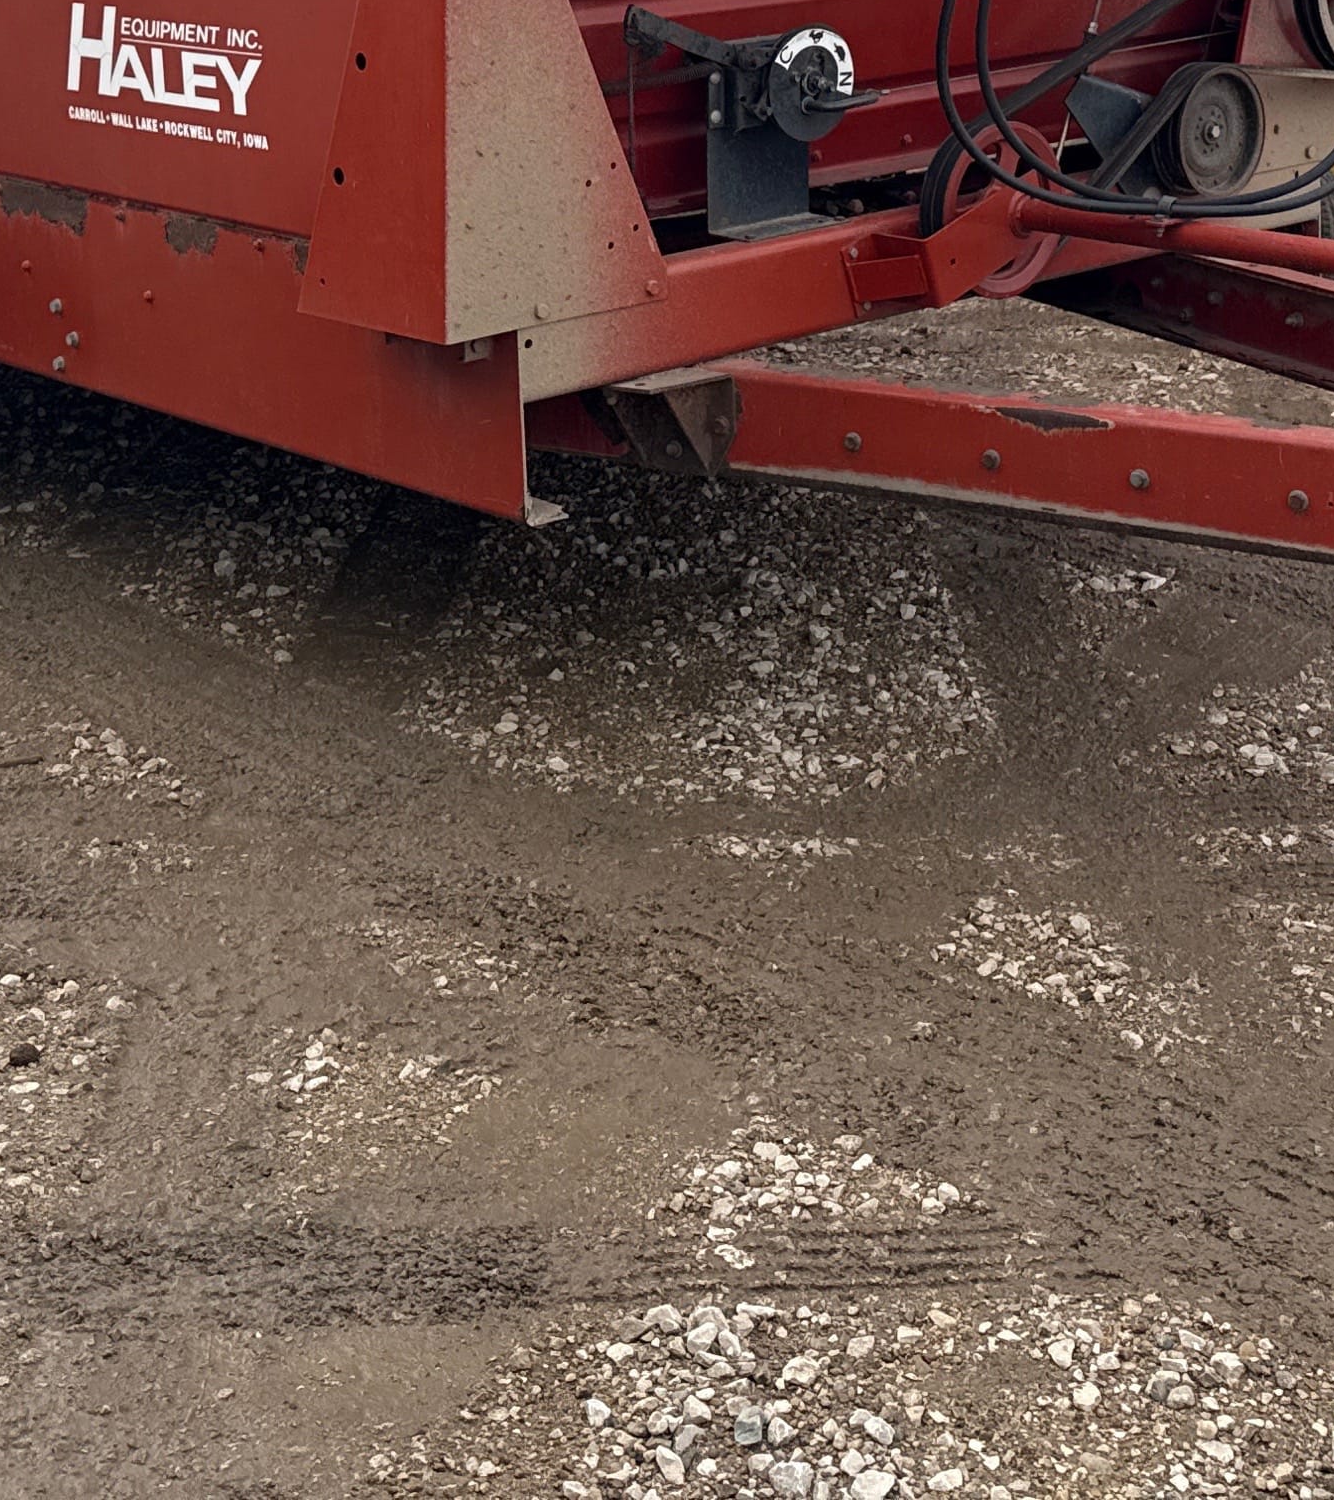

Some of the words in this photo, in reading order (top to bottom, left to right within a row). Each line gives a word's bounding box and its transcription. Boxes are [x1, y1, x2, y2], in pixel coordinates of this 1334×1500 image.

[120, 16, 220, 45] EQUIPMENT
[226, 27, 263, 50] INC.
[66, 2, 263, 116] HALEY
[779, 45, 794, 64] C
[839, 71, 853, 87] N
[68, 105, 106, 125] CARROLL
[110, 112, 134, 129] WALL
[135, 115, 159, 133] LAKE
[164, 120, 214, 142] ROCKWELL
[216, 128, 242, 149] CITY,
[243, 132, 269, 151] IOWA
